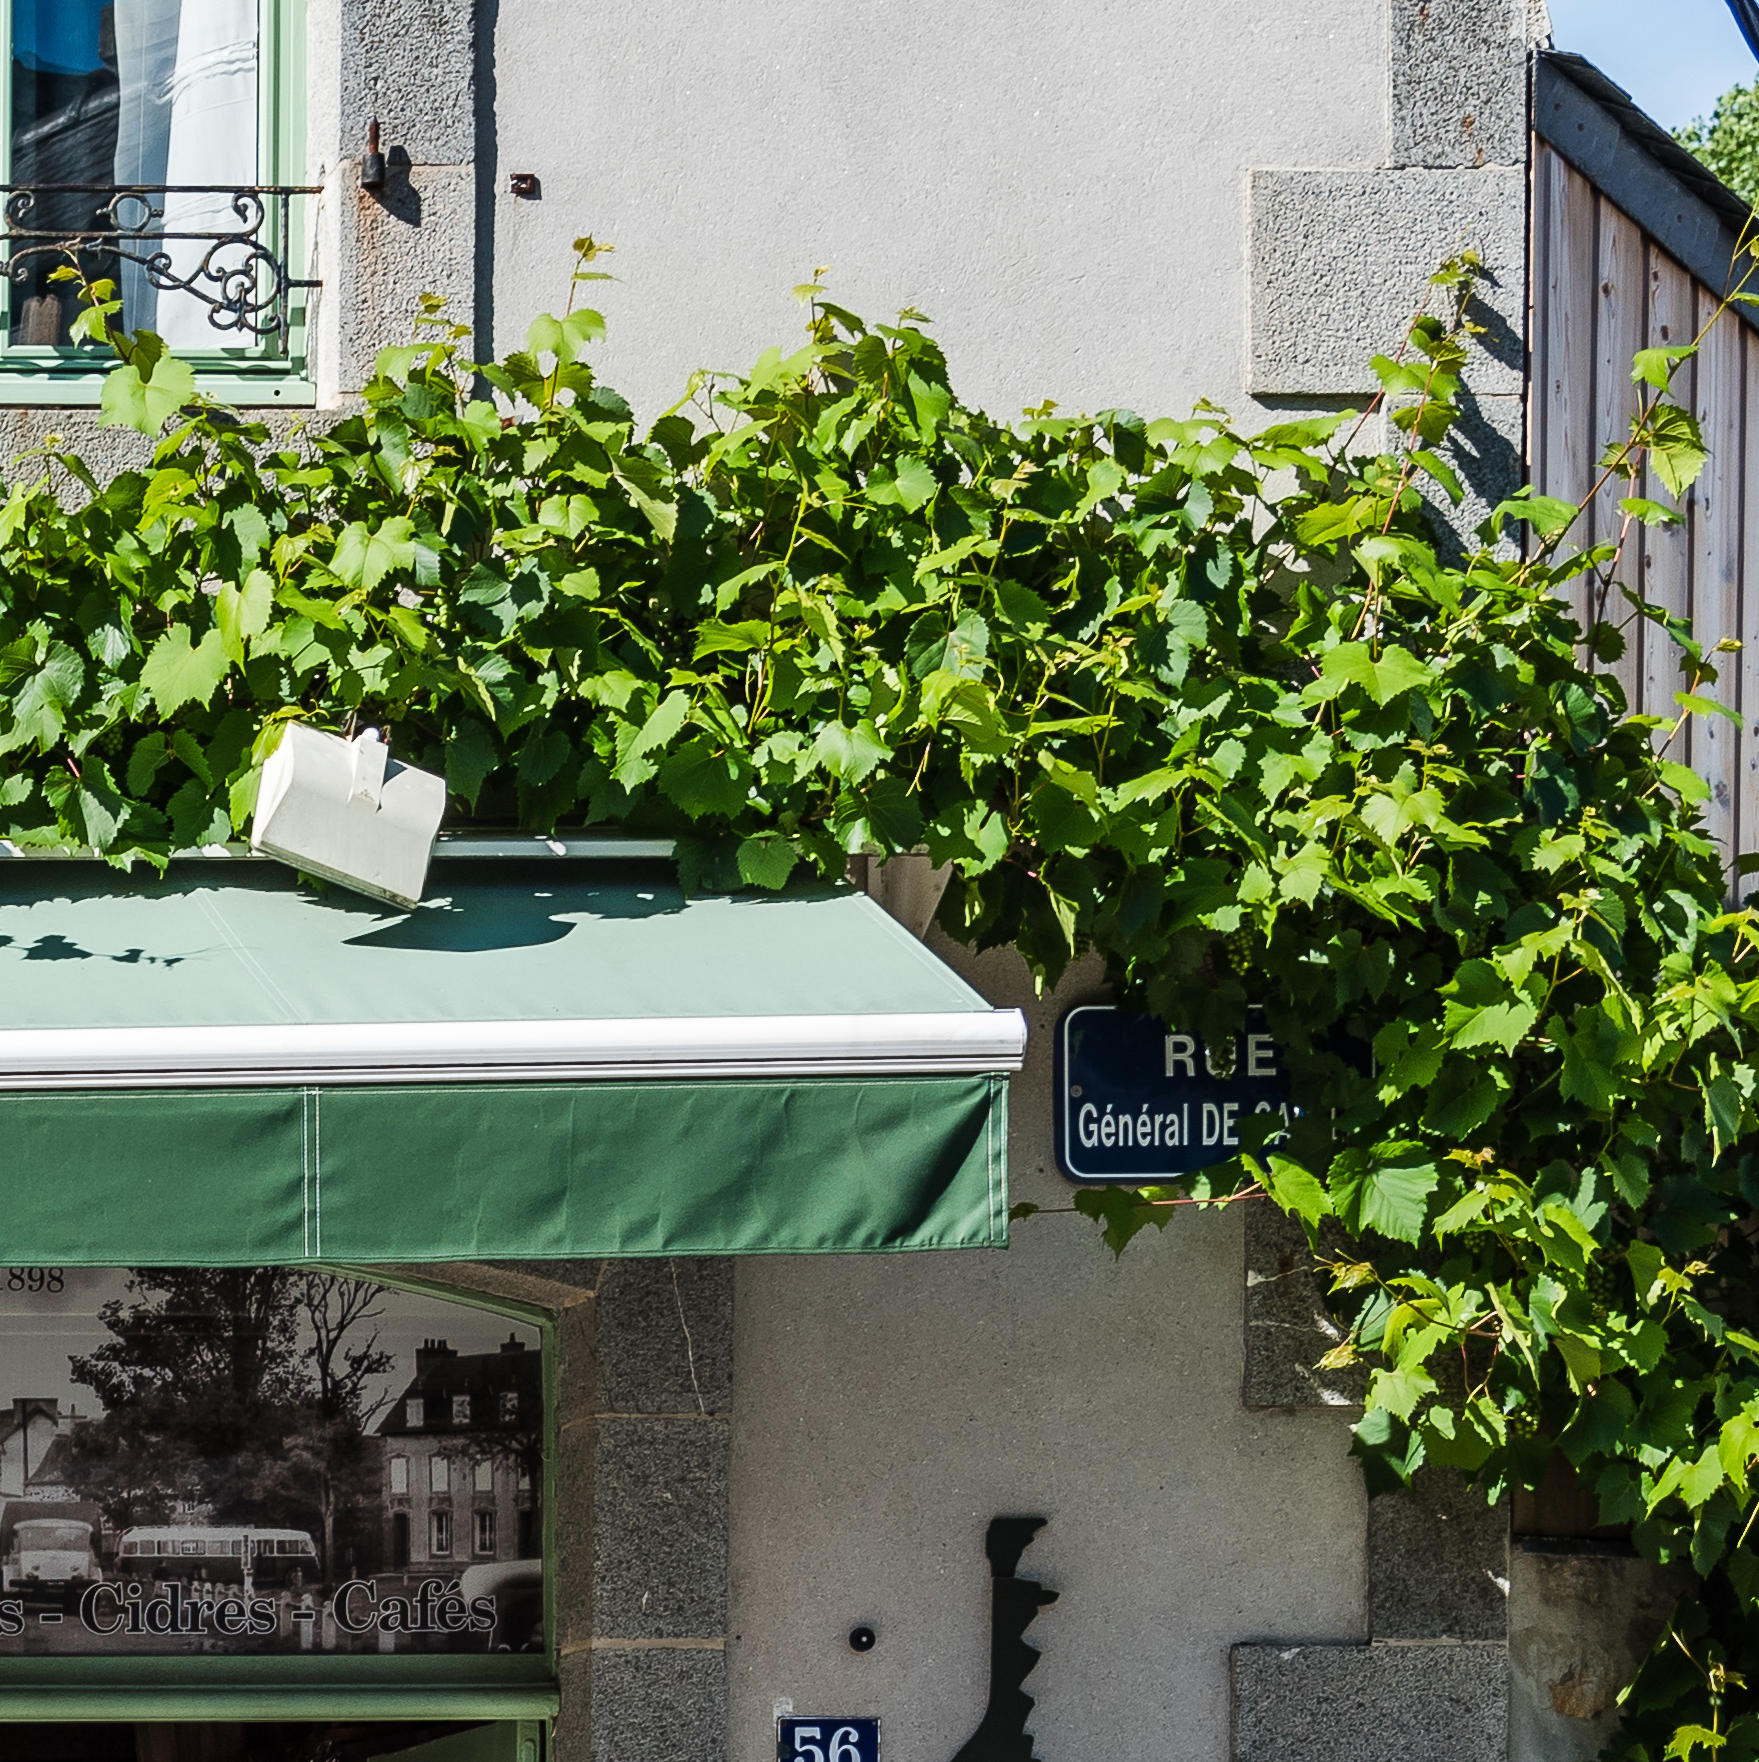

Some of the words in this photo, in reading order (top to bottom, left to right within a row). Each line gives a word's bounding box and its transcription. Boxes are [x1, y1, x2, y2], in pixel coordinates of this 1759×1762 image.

[1078, 1102, 1189, 1147] Général
[1202, 1103, 1239, 1145] DE
[80, 1581, 277, 1635] Cidres
[333, 1578, 498, 1634] Cafés
